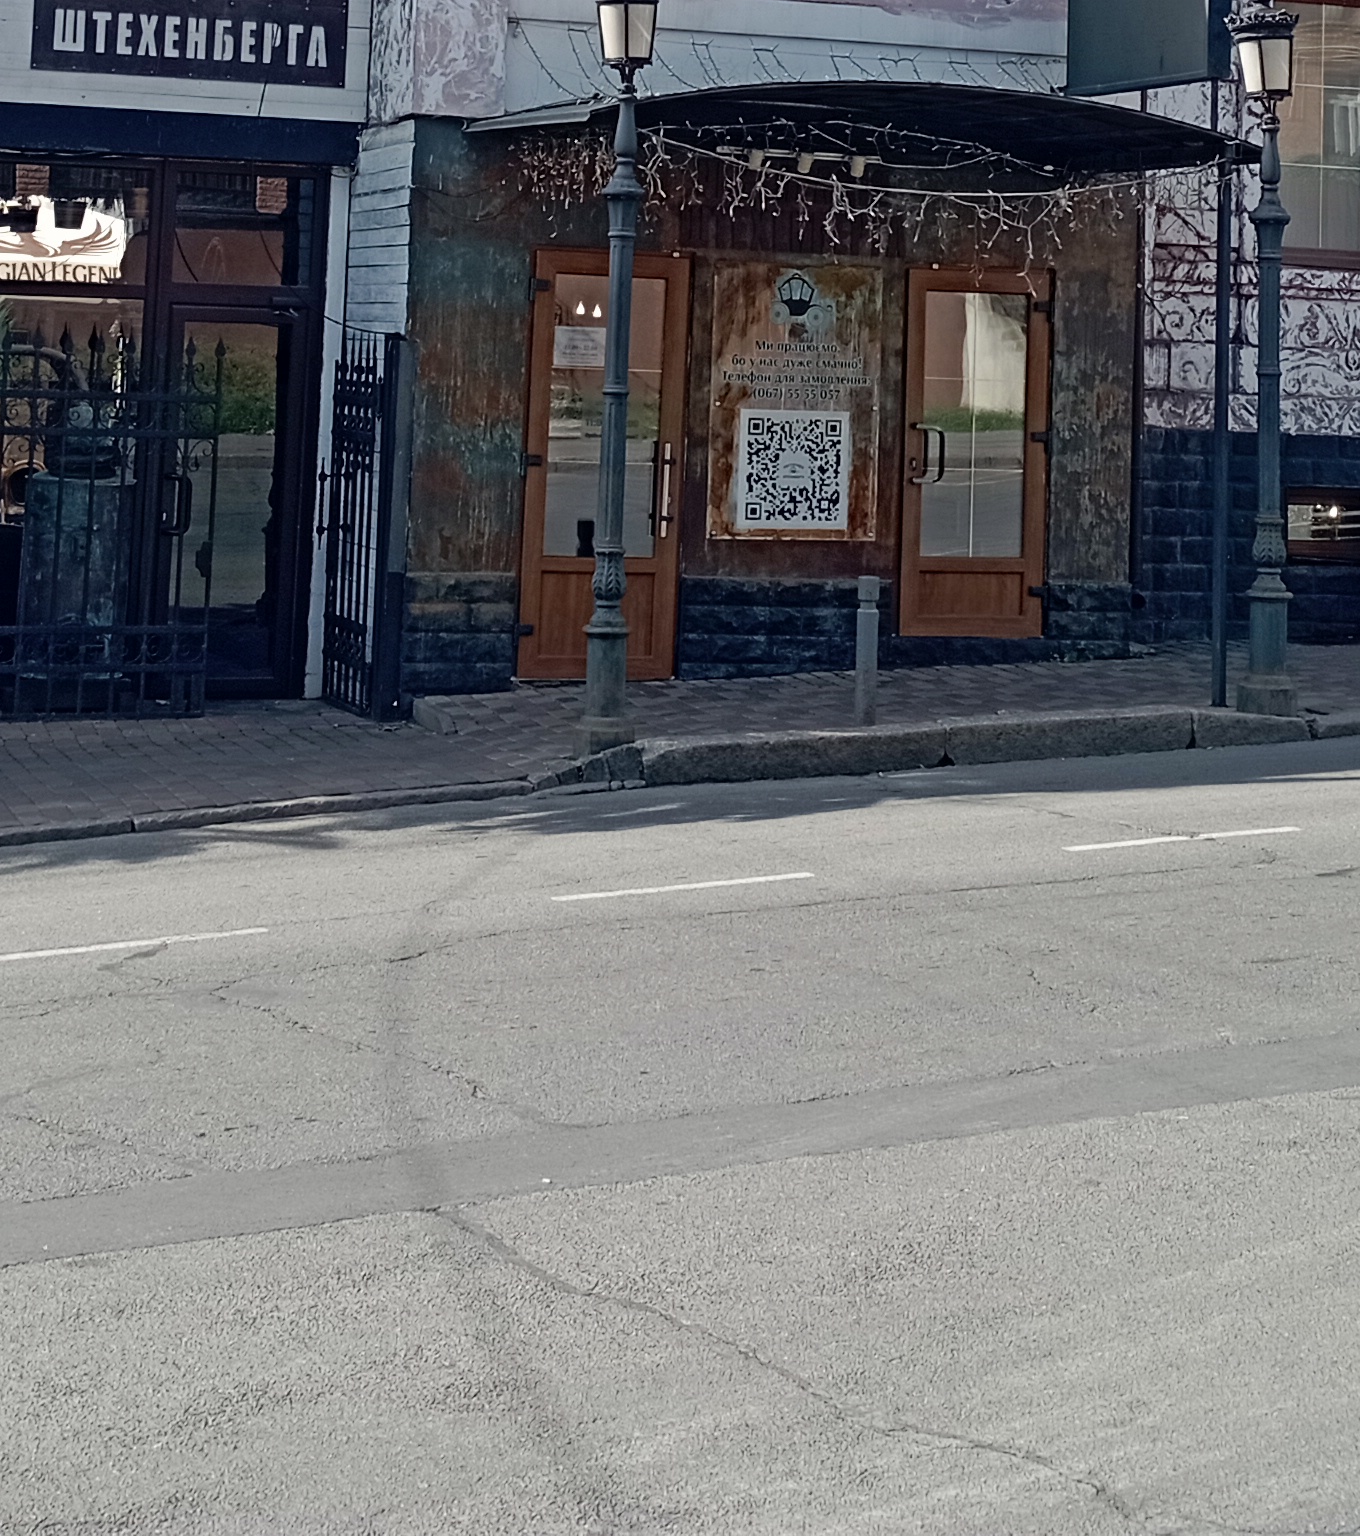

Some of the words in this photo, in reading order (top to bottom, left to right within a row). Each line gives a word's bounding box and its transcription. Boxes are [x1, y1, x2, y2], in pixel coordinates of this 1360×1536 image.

[53, 8, 328, 68] ШТЕХЕНБЕРГА
[755, 340, 774, 351] Ми
[731, 353, 746, 366] бо
[749, 358, 756, 369] у
[759, 358, 779, 367] нас
[783, 358, 813, 371] дуже
[816, 357, 862, 370] смачно!
[722, 370, 771, 385] Телефон
[774, 374, 795, 384] для
[753, 387, 783, 401] (067)
[787, 388, 800, 400] 55
[804, 388, 817, 400] 55
[819, 389, 841, 400] 057
